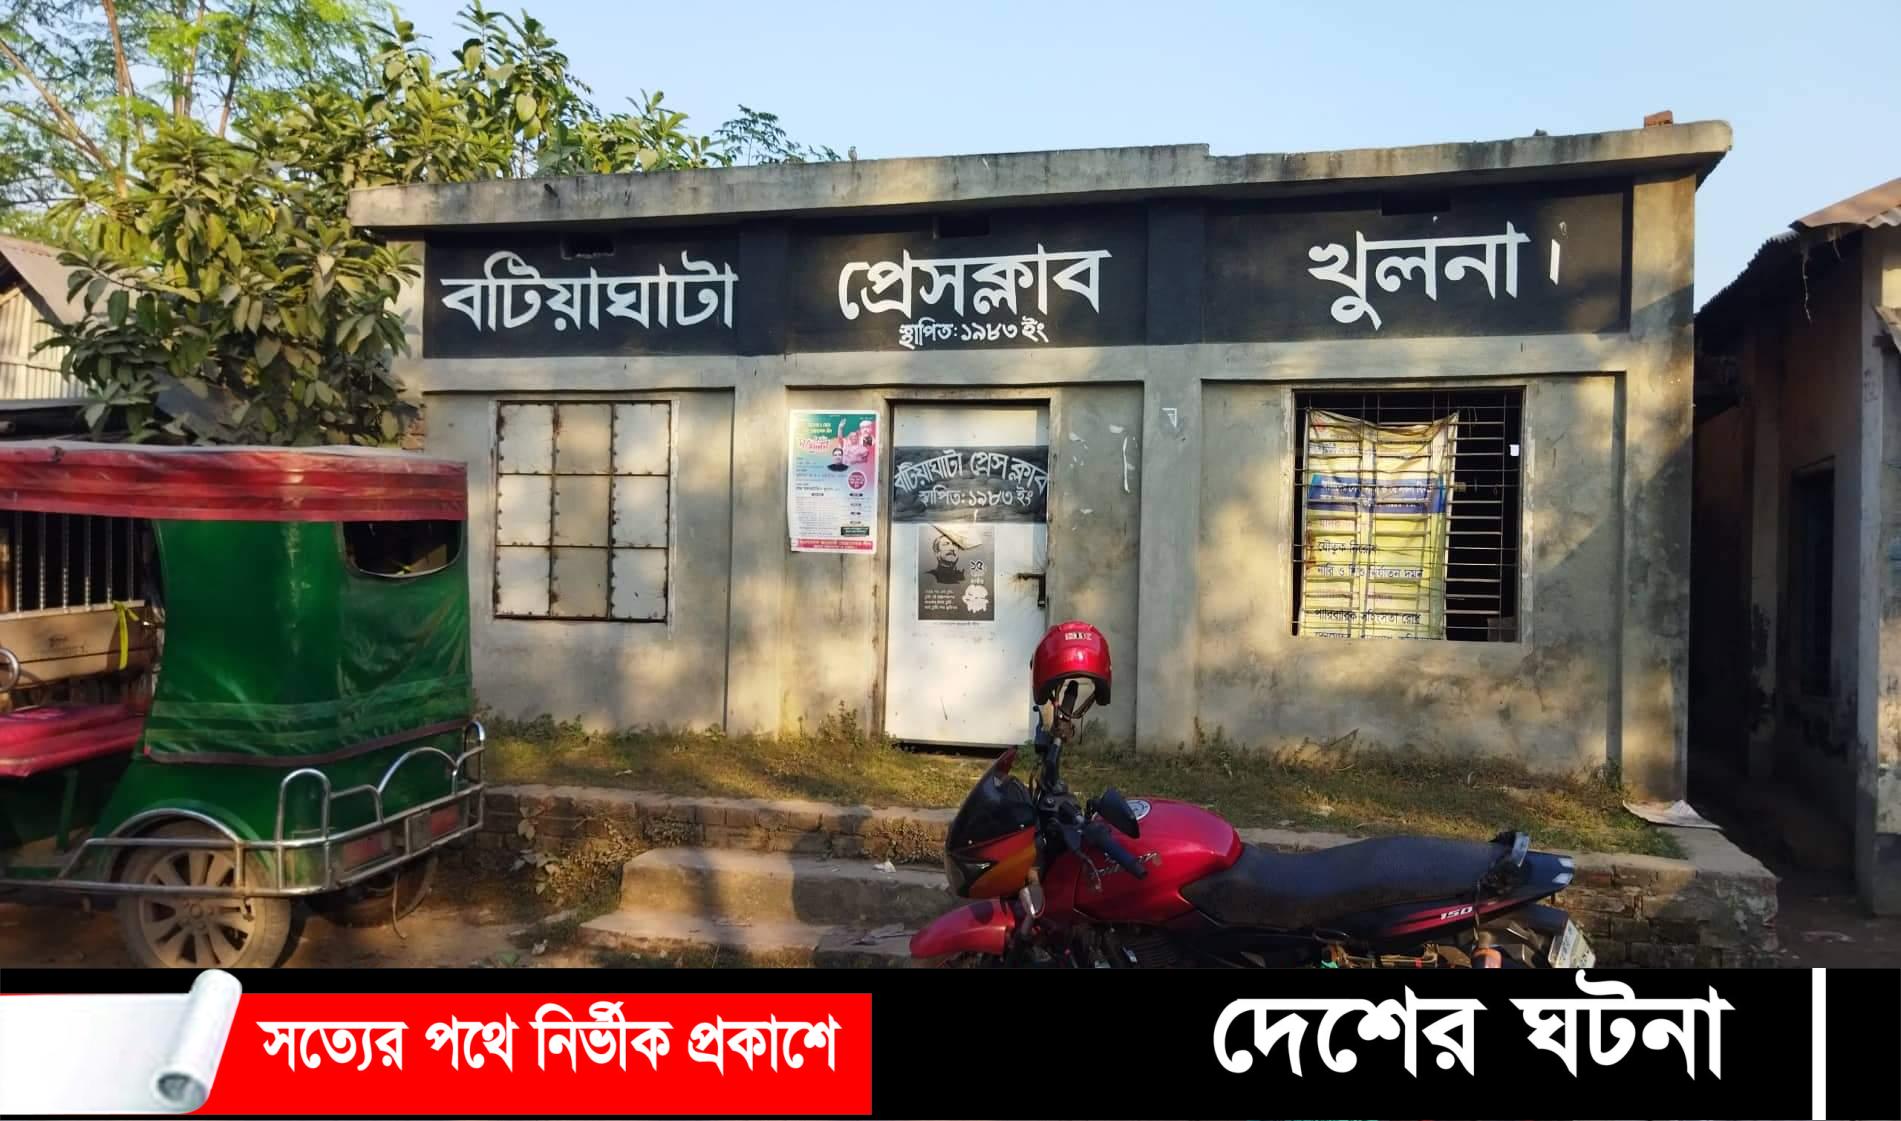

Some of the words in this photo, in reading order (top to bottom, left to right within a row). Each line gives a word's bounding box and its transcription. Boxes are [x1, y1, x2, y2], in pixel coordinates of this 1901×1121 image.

[440, 251, 738, 330] বটিয়াঘাটা
[839, 244, 1112, 319] প্রেসক্লাব
[1308, 222, 1530, 330] খুলনা
[961, 322, 1018, 342] ১৯৮৩
[1021, 316, 1049, 343] ইং
[895, 448, 963, 493] বটিয়াঘাটা
[968, 489, 1013, 506] ১৯৮৩
[1440, 906, 1472, 920] 150
